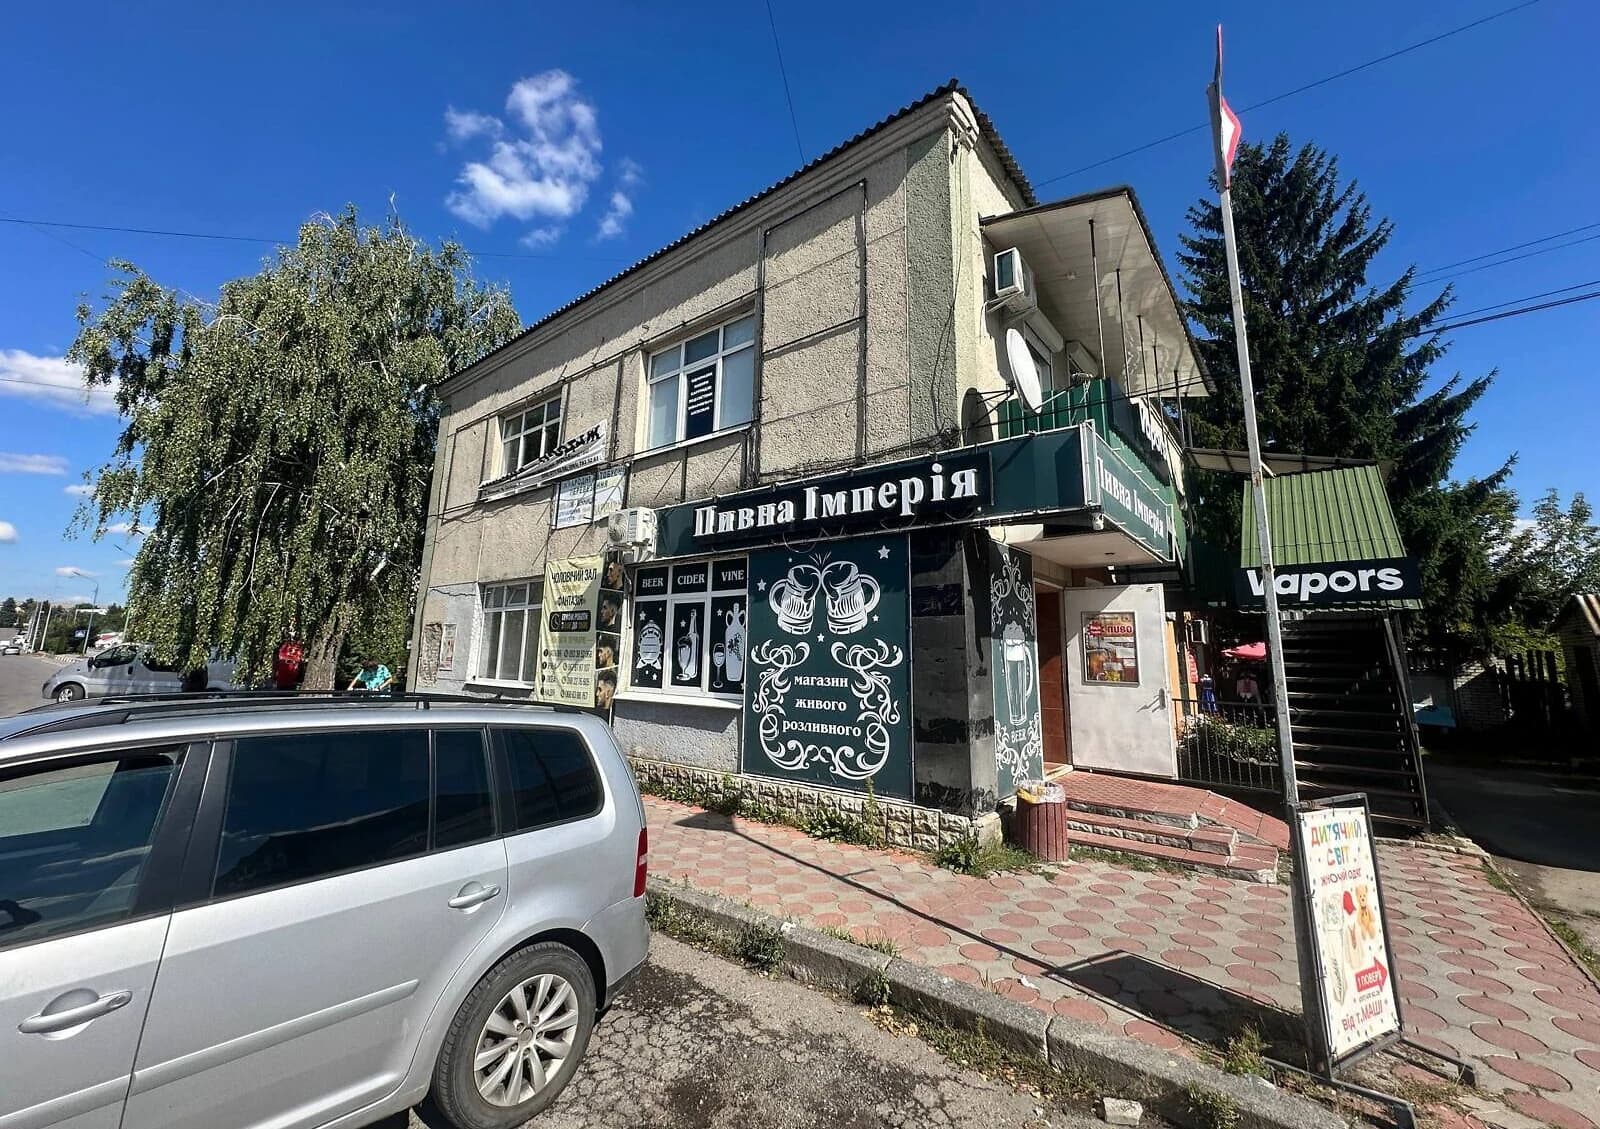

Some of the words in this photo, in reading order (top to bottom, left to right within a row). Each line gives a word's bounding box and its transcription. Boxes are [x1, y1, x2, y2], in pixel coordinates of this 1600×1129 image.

[693, 499, 795, 537] Пивна
[802, 463, 978, 516] Імперія
[1097, 456, 1132, 512] Пивна
[1133, 488, 1164, 538] Імперія
[584, 568, 597, 581] ЗАЛ
[642, 577, 664, 588] BEER
[677, 573, 705, 585] CIDER
[721, 569, 745, 581] VINE
[1246, 568, 1404, 601] Vapors
[794, 675, 849, 688] магазин
[795, 698, 847, 712] живого
[782, 720, 862, 737] розливного
[1311, 819, 1362, 848] ДИТЯЧИЙ
[1327, 846, 1350, 866] СВІТ
